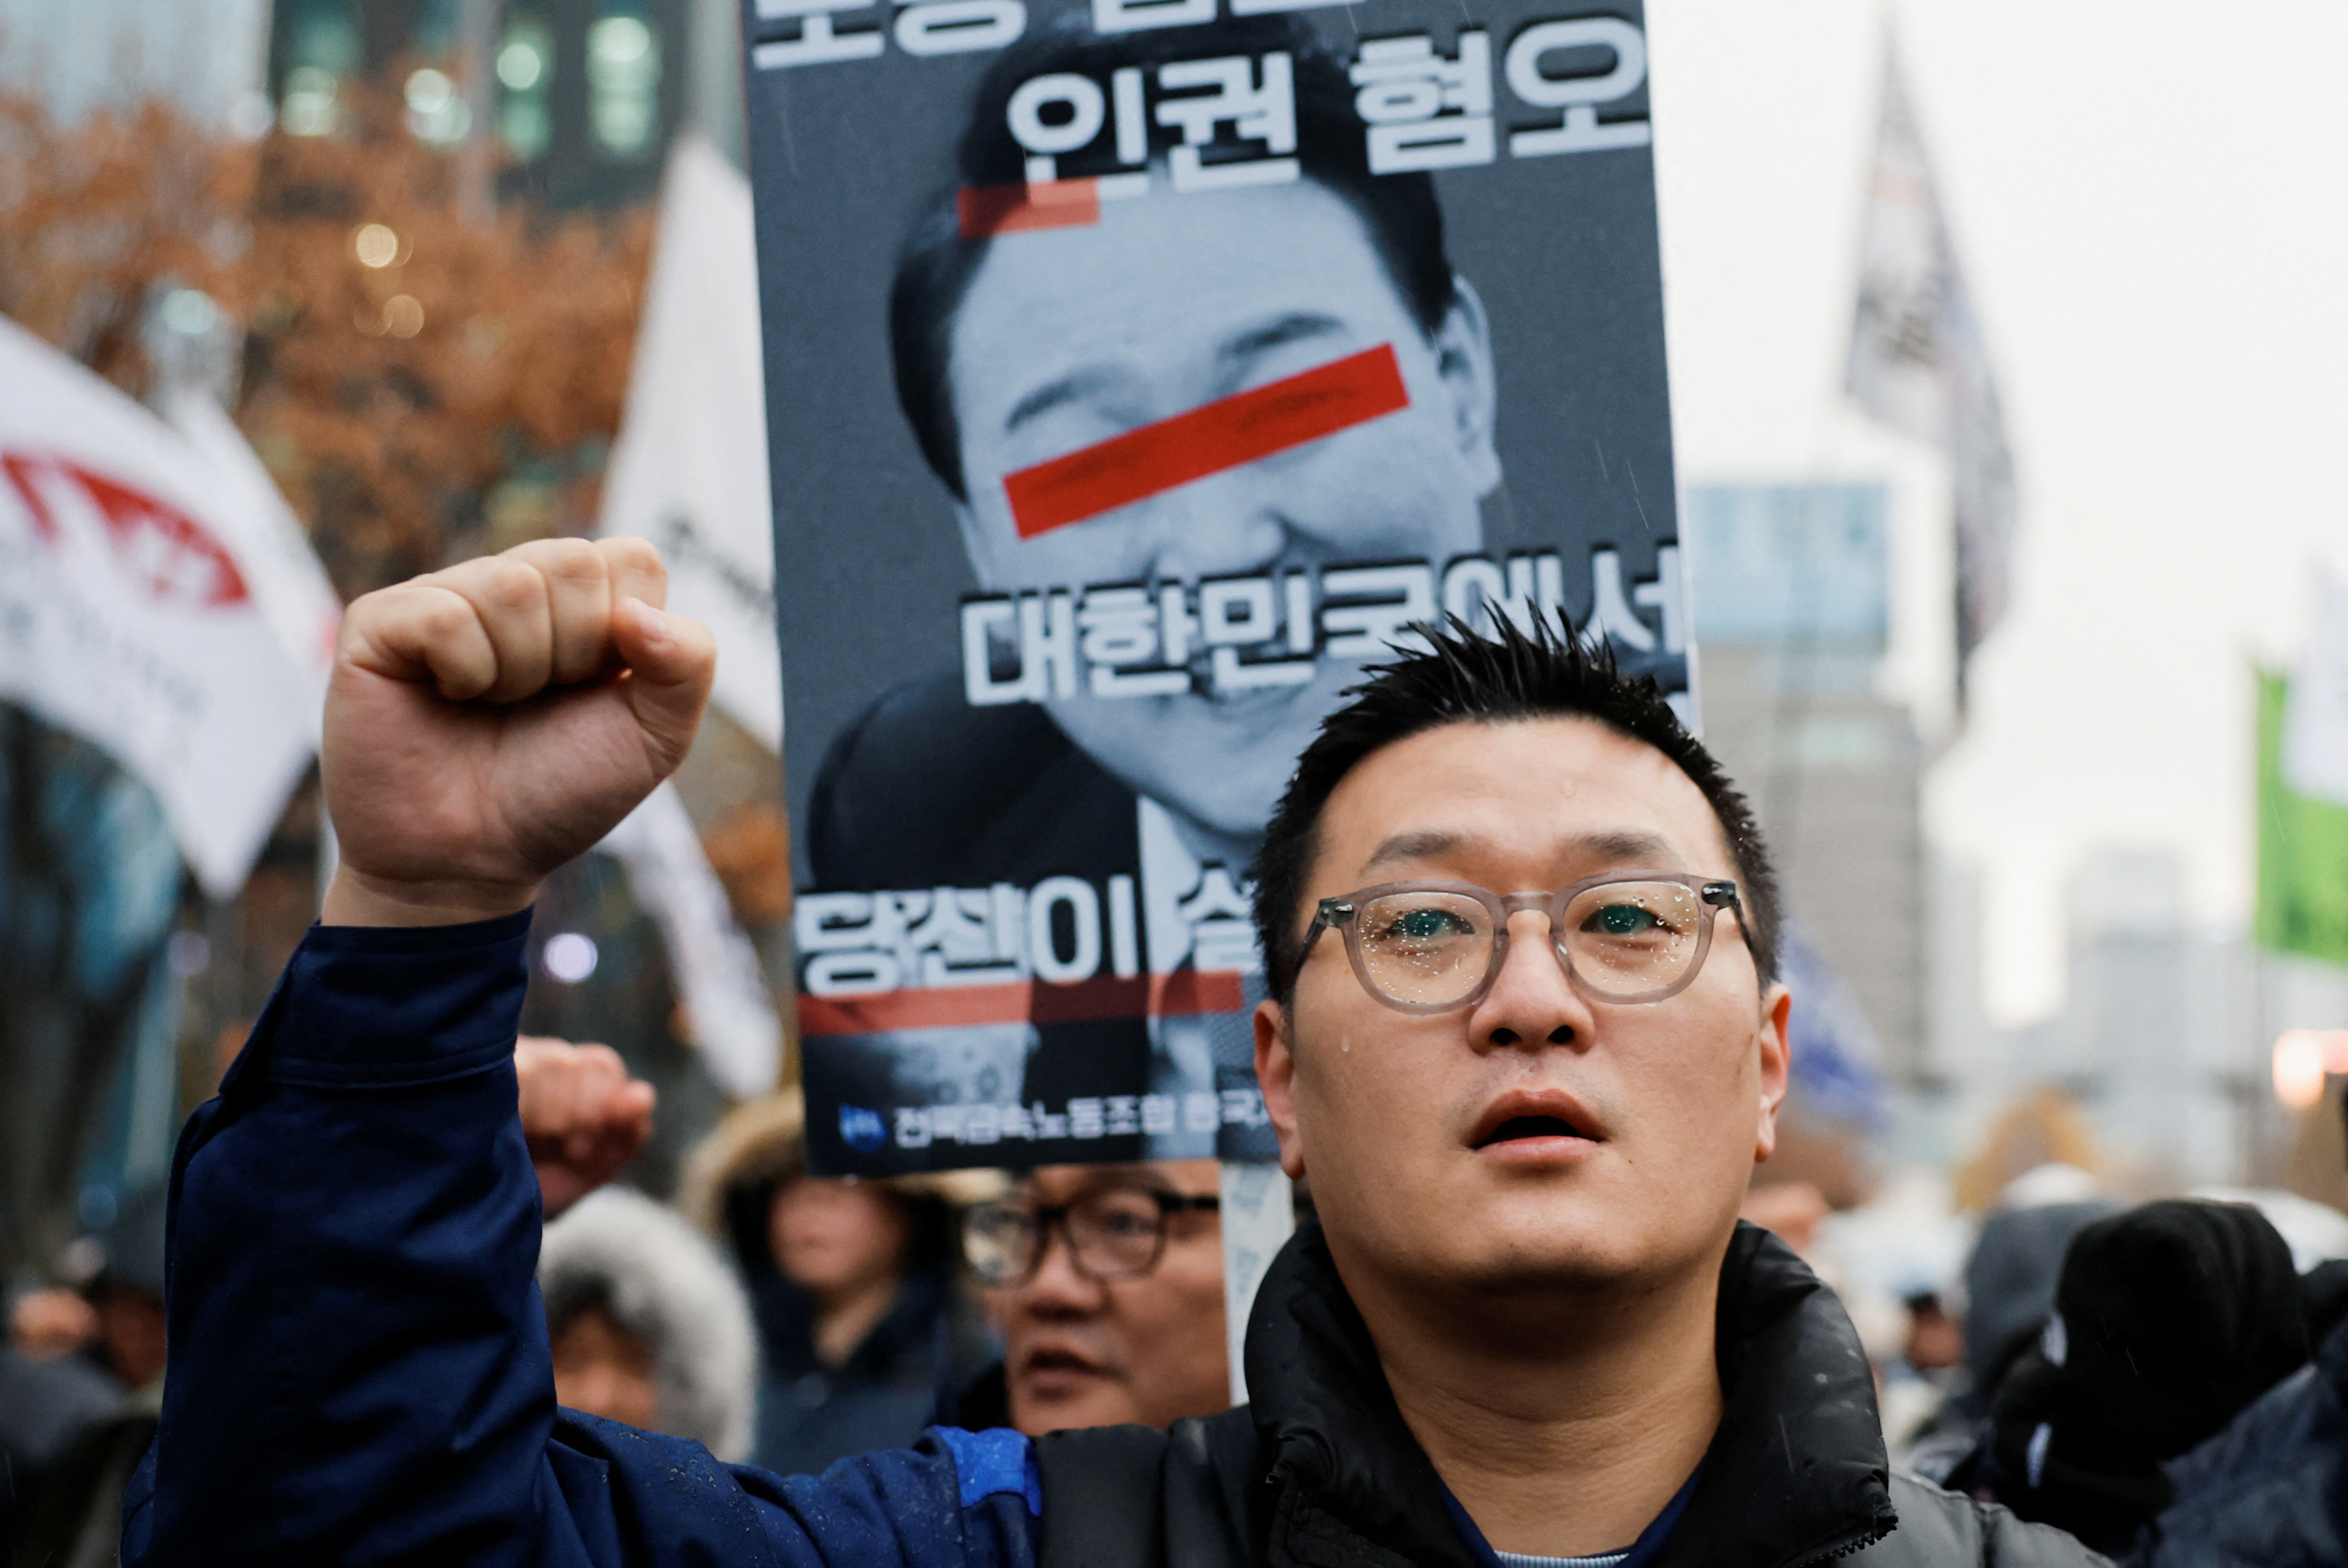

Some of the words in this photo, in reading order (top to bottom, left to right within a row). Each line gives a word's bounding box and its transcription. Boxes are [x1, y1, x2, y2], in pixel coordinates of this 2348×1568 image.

[1006, 51, 1302, 204] 인권
[1350, 15, 1651, 175] 혐오
[960, 546, 1686, 705] 대한민국에서
[793, 873, 1139, 998] 당신이
